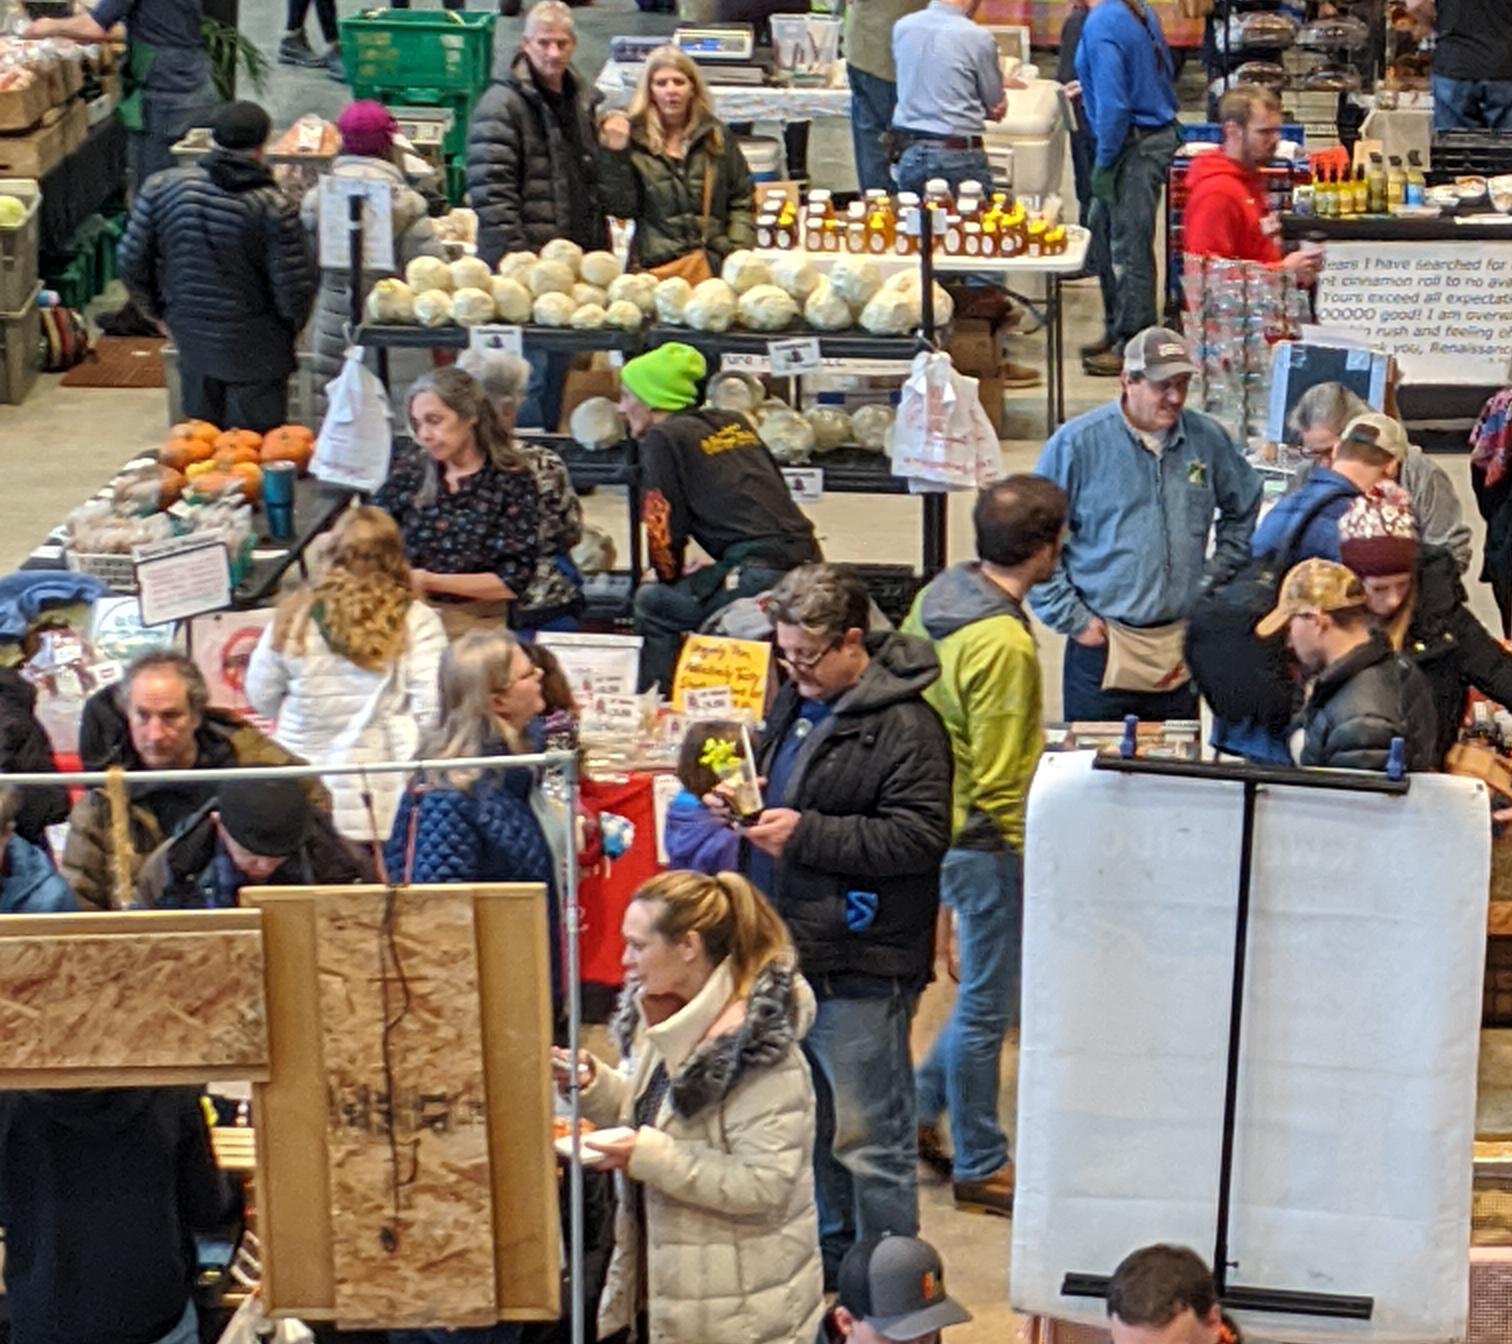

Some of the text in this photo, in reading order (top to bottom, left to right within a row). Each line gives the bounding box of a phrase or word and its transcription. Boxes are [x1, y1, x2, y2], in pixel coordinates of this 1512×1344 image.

[1375, 257, 1410, 270] have
[1416, 259, 1482, 271] searched
[1487, 258, 1506, 270] for
[1341, 277, 1413, 287] cinnamon
[1418, 276, 1441, 286] roll
[1446, 276, 1461, 287] to
[1465, 278, 1484, 288] no
[1323, 292, 1363, 303] Yours
[1367, 293, 1420, 304] exceed
[1424, 292, 1442, 303] all
[1380, 309, 1422, 323] good!
[1438, 311, 1462, 321] am
[1376, 326, 1408, 337] rush
[1413, 325, 1440, 336] and
[1430, 341, 1512, 355] Renaissanc
